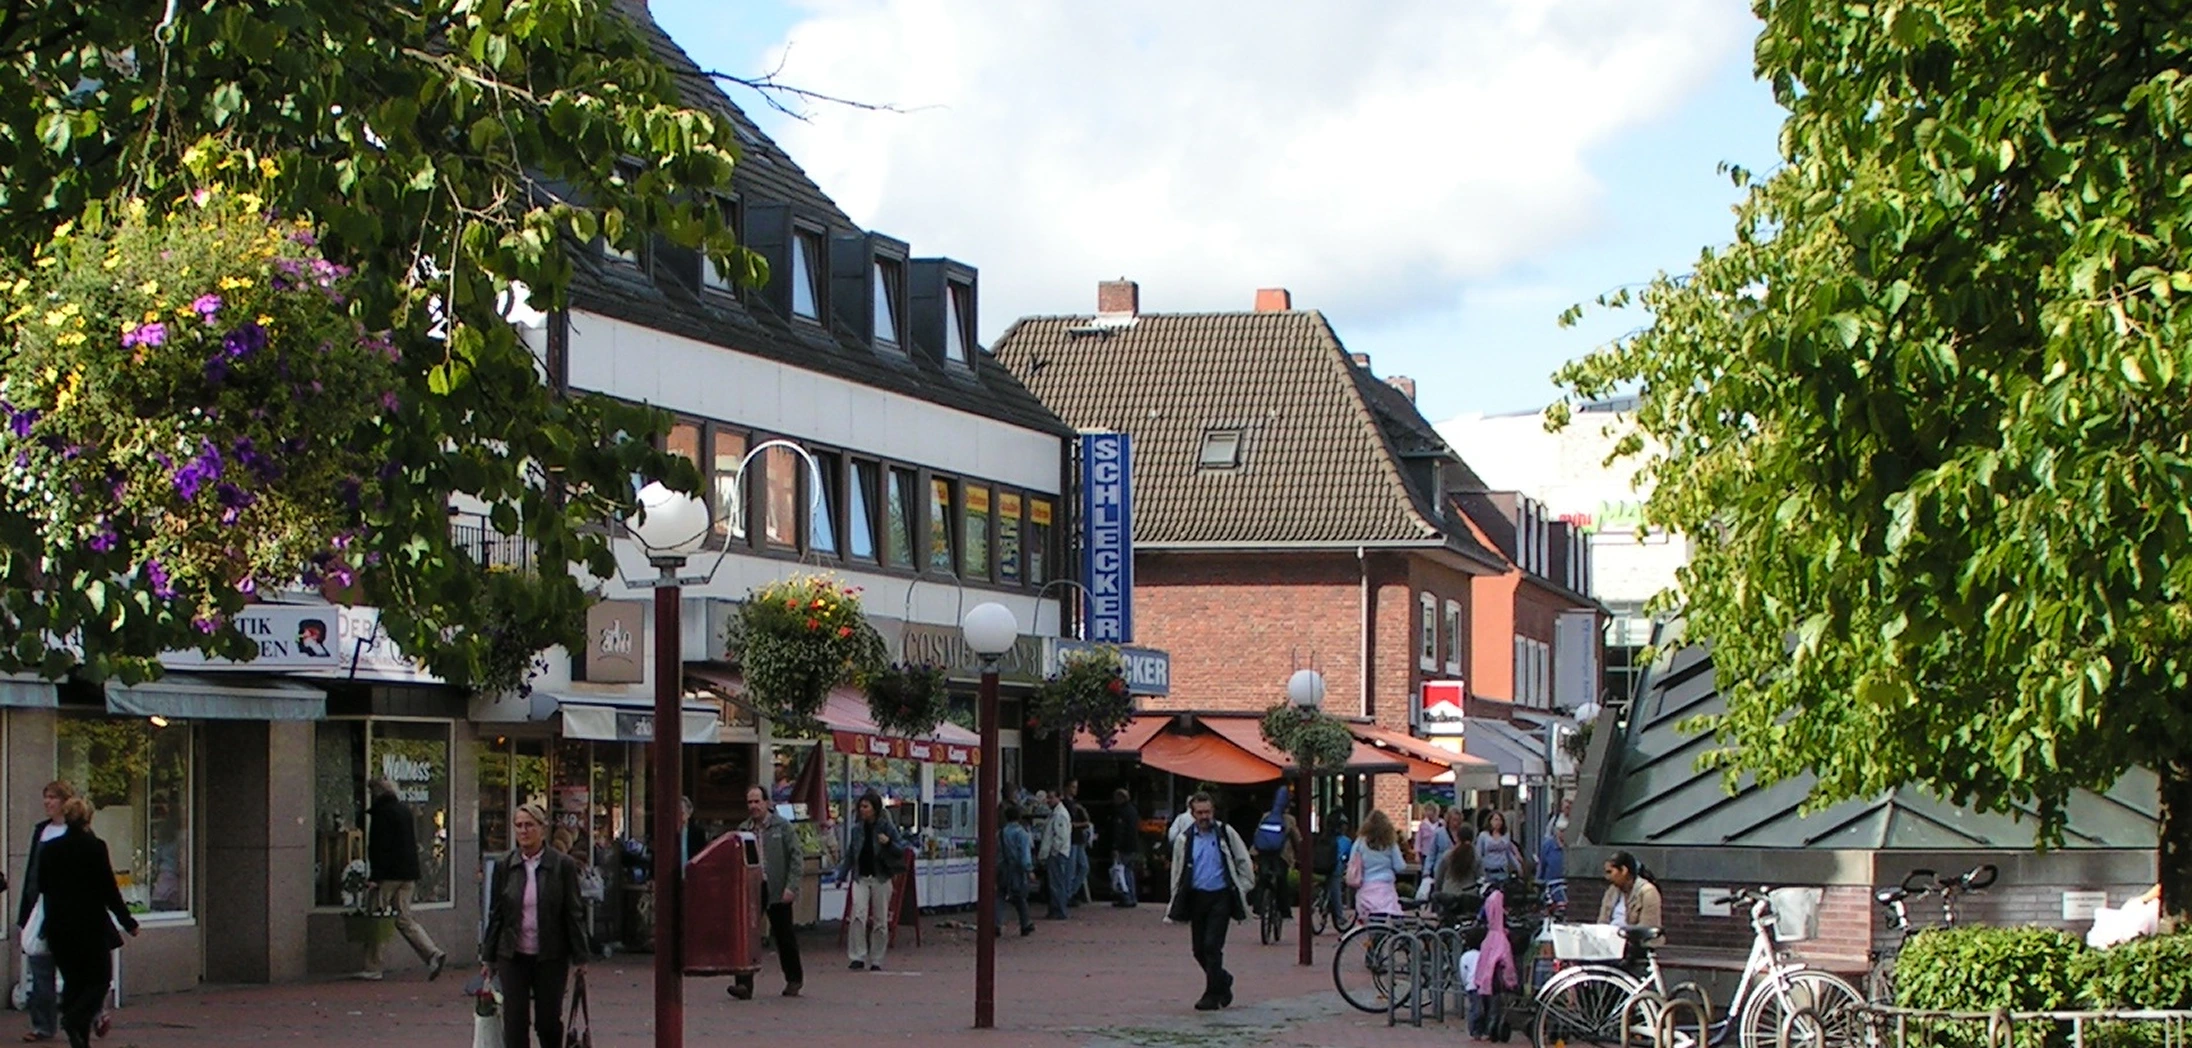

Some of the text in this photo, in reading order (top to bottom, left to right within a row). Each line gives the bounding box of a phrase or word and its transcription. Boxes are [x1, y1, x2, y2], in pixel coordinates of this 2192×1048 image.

[1094, 438, 1119, 638] SCHLECKER
[236, 617, 272, 635] TIK
[259, 640, 288, 657] EN
[1058, 647, 1168, 686] SCKER
[382, 753, 431, 781] Wellness
